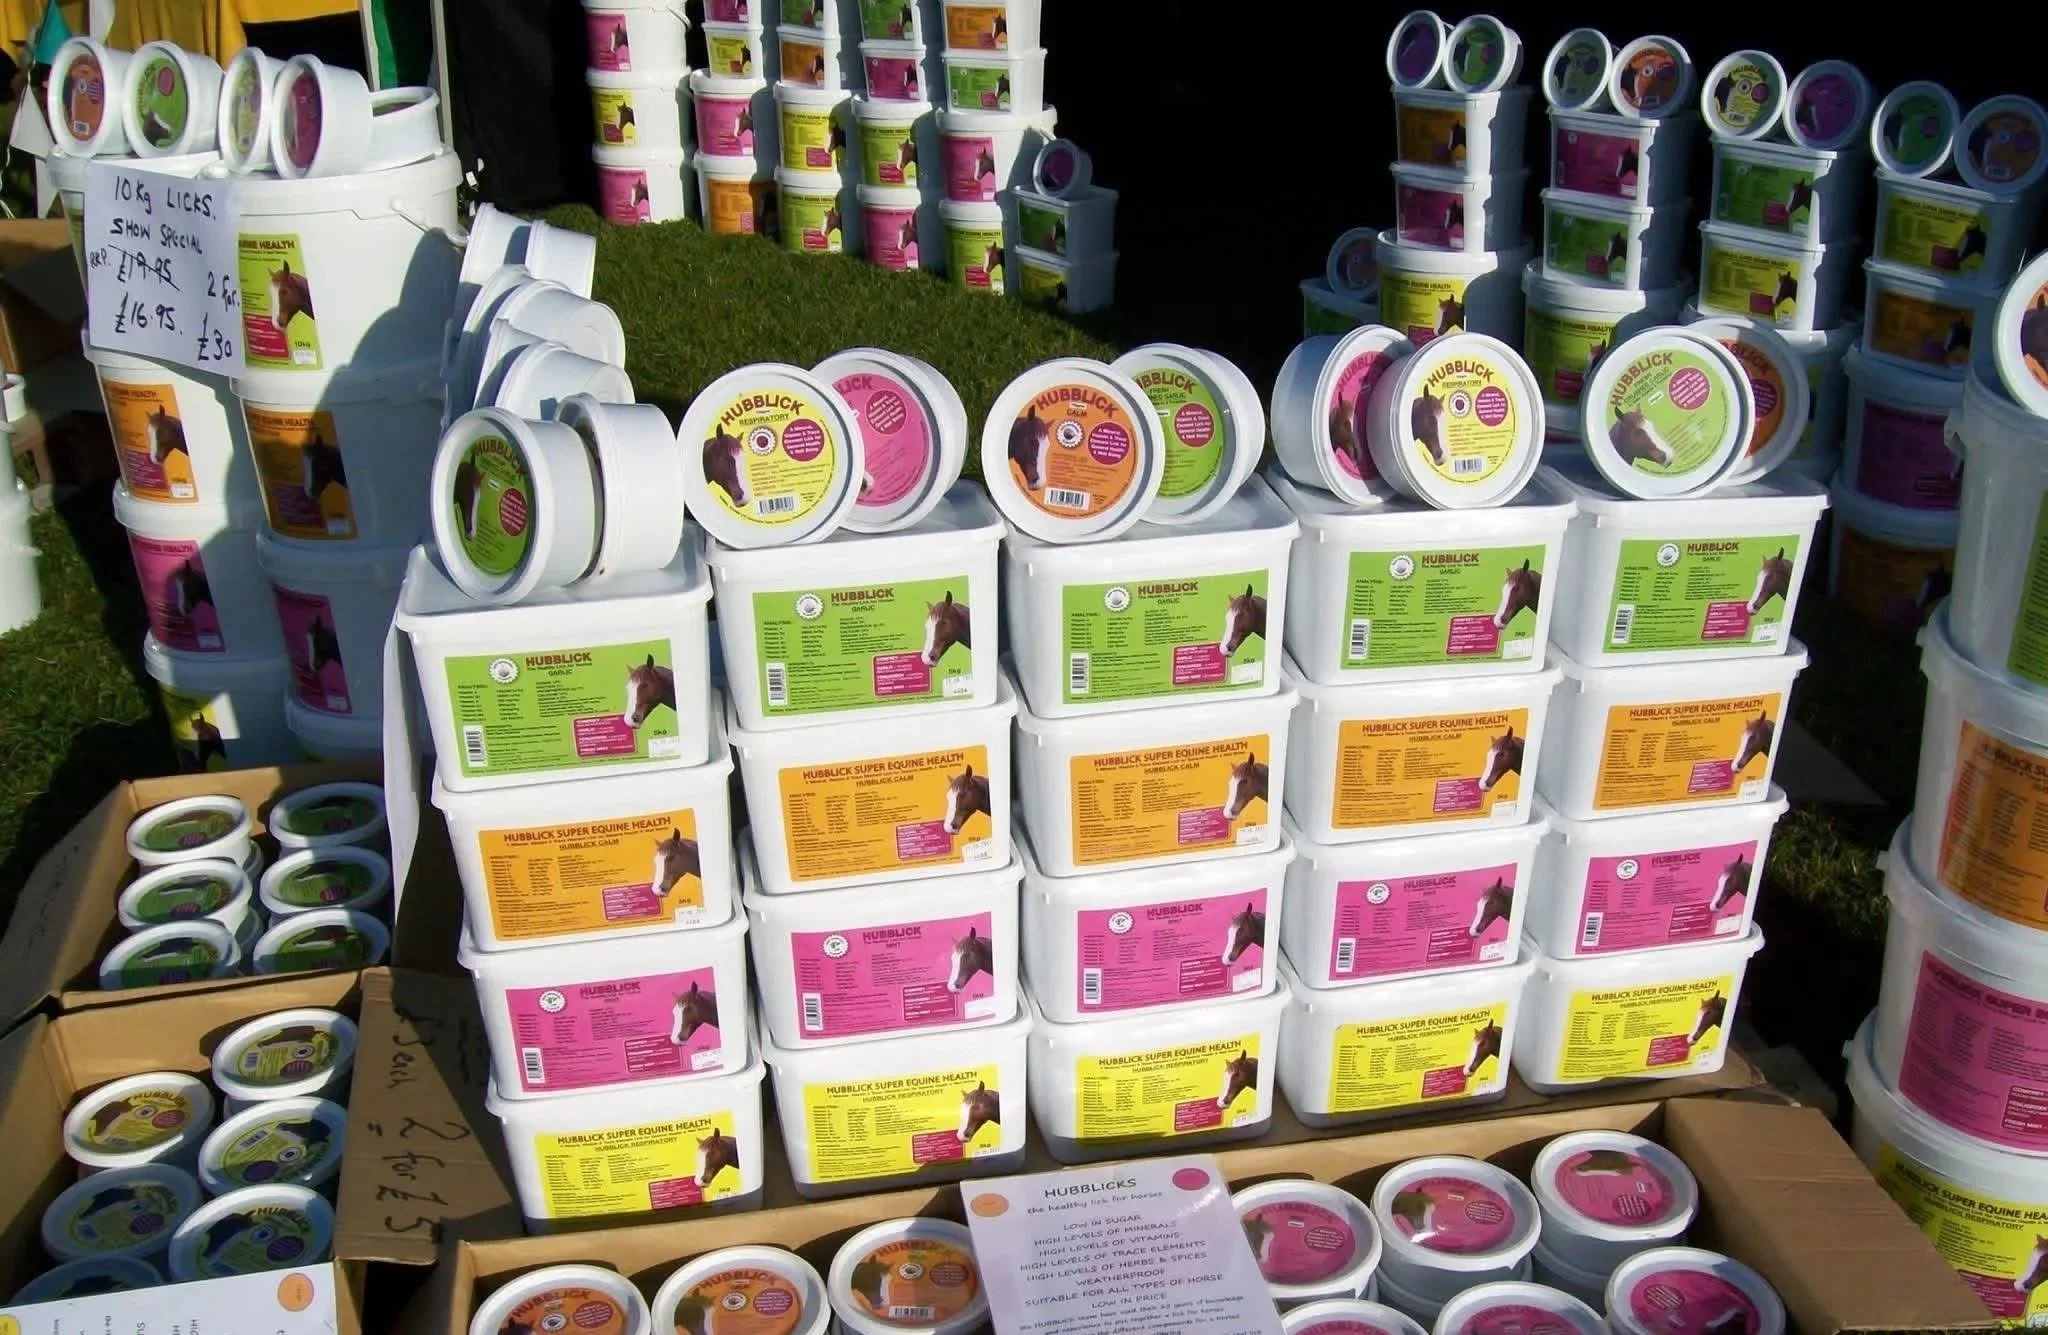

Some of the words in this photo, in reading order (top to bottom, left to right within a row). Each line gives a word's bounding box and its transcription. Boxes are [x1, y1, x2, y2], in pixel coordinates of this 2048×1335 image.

[110, 218, 150, 240] SHOW
[160, 224, 202, 254] SPECIAL
[259, 240, 295, 249] HEALTH
[207, 272, 215, 298] 2
[198, 313, 232, 361] £30
[837, 374, 872, 394] LICK
[1428, 360, 1494, 387] HUBBLICK
[1610, 352, 1672, 406] HUBBLICK
[721, 395, 804, 426] HUBBLICK
[1037, 388, 1118, 418] HUBBLICK
[1067, 408, 1087, 418] CALM
[739, 413, 790, 426] RESPIRATORY
[1688, 542, 1739, 551] HUBBLICK
[1422, 553, 1479, 564] HUBBLICK
[831, 588, 894, 602] HUBBLICK
[1138, 581, 1198, 595] HUBBLICK
[525, 652, 592, 667] HUBBLICK
[1629, 708, 1672, 717] HUBBLICK
[1673, 706, 1700, 714] SUPER
[1701, 704, 1732, 713] EQUINE
[1733, 699, 1765, 709] HEALTH
[1362, 723, 1408, 733] HUBBLICK
[1410, 721, 1438, 729] SUPER
[1440, 719, 1473, 728] EQUINE
[1475, 715, 1508, 725] HEALTH
[1094, 755, 1141, 767] HUBBLICK
[1143, 752, 1173, 763] SUPER
[1176, 747, 1211, 758] EQUINE
[1213, 741, 1248, 752] HEALTH
[803, 767, 853, 779] HUBBLICK
[854, 763, 885, 775] SUPER
[887, 759, 925, 771] EQUINE
[927, 752, 964, 766] HEALTH
[504, 831, 555, 843] HUBBLICK
[557, 828, 590, 838] SUPER
[592, 823, 630, 834] EQUINE
[632, 816, 671, 829] HEALTH
[1652, 853, 1701, 865] HUBBLICK
[1404, 876, 1456, 889] HUBBLICK
[1147, 904, 1203, 917] HUBBLICK
[863, 927, 922, 941] HUBBLICK
[580, 982, 640, 998] HUBBLICK
[1592, 992, 1630, 1001] HUBBLICK
[1632, 989, 1657, 997] SUPER
[1658, 986, 1687, 994] EQUINE
[1689, 981, 1718, 991] HEALTH
[1357, 1024, 1398, 1035] HUBBLICK
[1399, 1020, 1426, 1030] SUPER
[1428, 1016, 1458, 1025] EQUINE
[1460, 1010, 1490, 1021] HEALTH
[1099, 1055, 1142, 1066] HUBBLICK
[1145, 1051, 1172, 1062] SUPER
[1174, 1046, 1206, 1057] EQUINE
[1209, 1041, 1241, 1051] HEALTH
[827, 1083, 873, 1093] HUBBLICK
[874, 1080, 904, 1090] SUPER
[906, 1076, 940, 1086] EQUINE
[942, 1071, 977, 1083] HEALTH
[399, 1117, 471, 1142] 2
[558, 1133, 604, 1144] HUBBLICK
[606, 1129, 636, 1141] SUPER
[638, 1124, 674, 1136] EQUINE
[676, 1119, 712, 1131] HEALTH
[381, 1151, 446, 1183] for
[1045, 1178, 1137, 1198] HUBBLICKS
[1049, 1201, 1087, 1213] healthy
[1091, 1197, 1107, 1207] lick
[1112, 1194, 1129, 1205] for
[1131, 1191, 1163, 1200] horses
[1942, 1188, 1977, 1208] SUPER
[1978, 1204, 2021, 1218] EQUINE
[1034, 1238, 1061, 1246] HIGH
[1065, 1230, 1103, 1241] LEVELS
[1124, 1221, 1177, 1233] MINERALS
[1064, 1221, 1087, 1231] LOW
[1105, 1215, 1142, 1225] SUGAR
[1965, 1214, 2024, 1231] RESPIRATORY
[1020, 1263, 1047, 1271] HIGH
[1050, 1255, 1090, 1267] LEVELS
[1094, 1252, 1108, 1260] OF
[1112, 1248, 1145, 1257] TRACE
[1151, 1240, 1206, 1253] ELEMENTS
[1039, 1249, 1067, 1258] HIGH
[1069, 1240, 1108, 1254] LEVELS
[1112, 1237, 1127, 1246] OF
[1130, 1231, 1181, 1243] VITAMINS
[1057, 1265, 1098, 1277] LEVELS
[1101, 1263, 1115, 1271] OF
[1119, 1258, 1154, 1268] HERBS
[1170, 1252, 1207, 1261] SPICES
[1076, 1269, 1165, 1287] WEATHERPROOF
[1025, 1293, 1078, 1307] SUITABLE
[1082, 1289, 1103, 1297] FOR
[1108, 1286, 1129, 1294] ALL
[1133, 1280, 1165, 1290] TYPES
[1188, 1274, 1224, 1282] HORSE
[1091, 1301, 1115, 1309] LOW
[1136, 1292, 1167, 1302] PRICE
